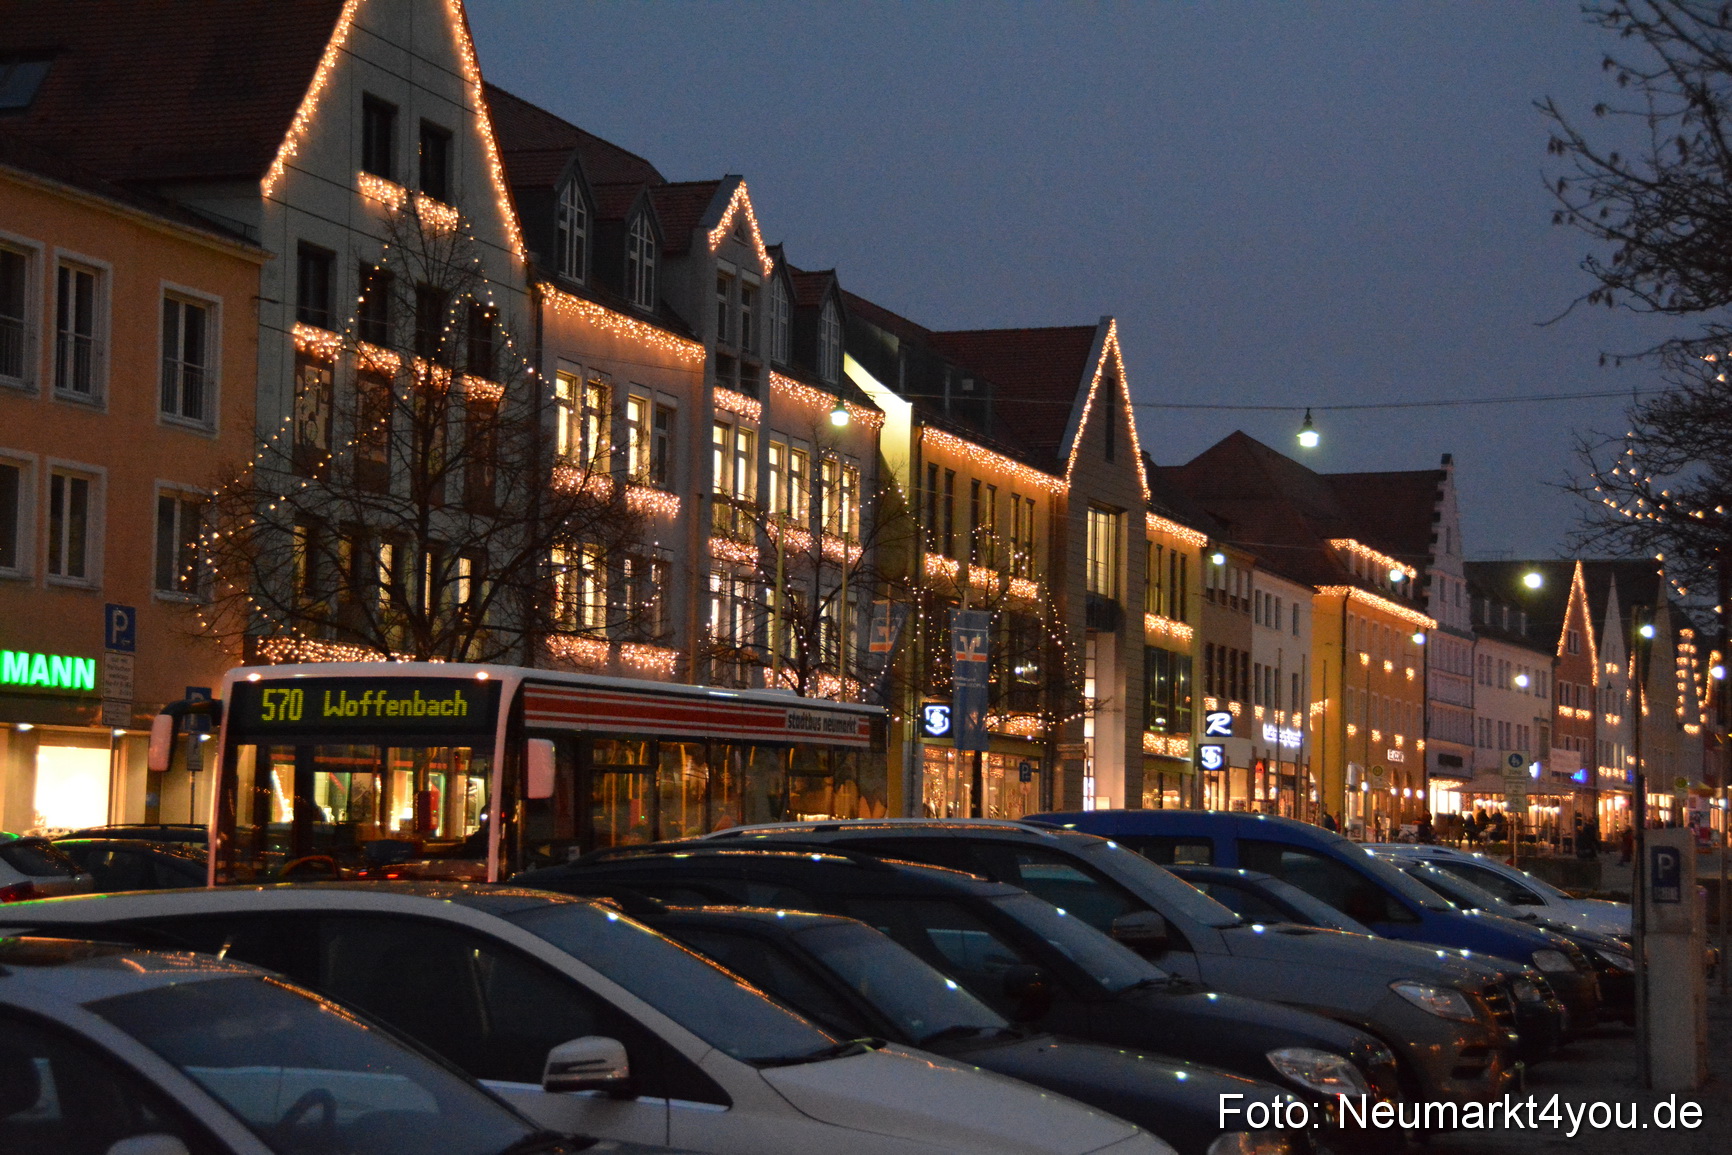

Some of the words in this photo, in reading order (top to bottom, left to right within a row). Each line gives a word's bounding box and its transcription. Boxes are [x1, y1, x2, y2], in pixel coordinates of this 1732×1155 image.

[111, 608, 129, 645] P
[0, 649, 96, 691] MANN
[261, 688, 304, 721] 570
[323, 689, 468, 717] Woffenbach
[788, 711, 822, 732] stadtbus
[823, 715, 857, 735] neumarkt
[1657, 852, 1674, 879] P
